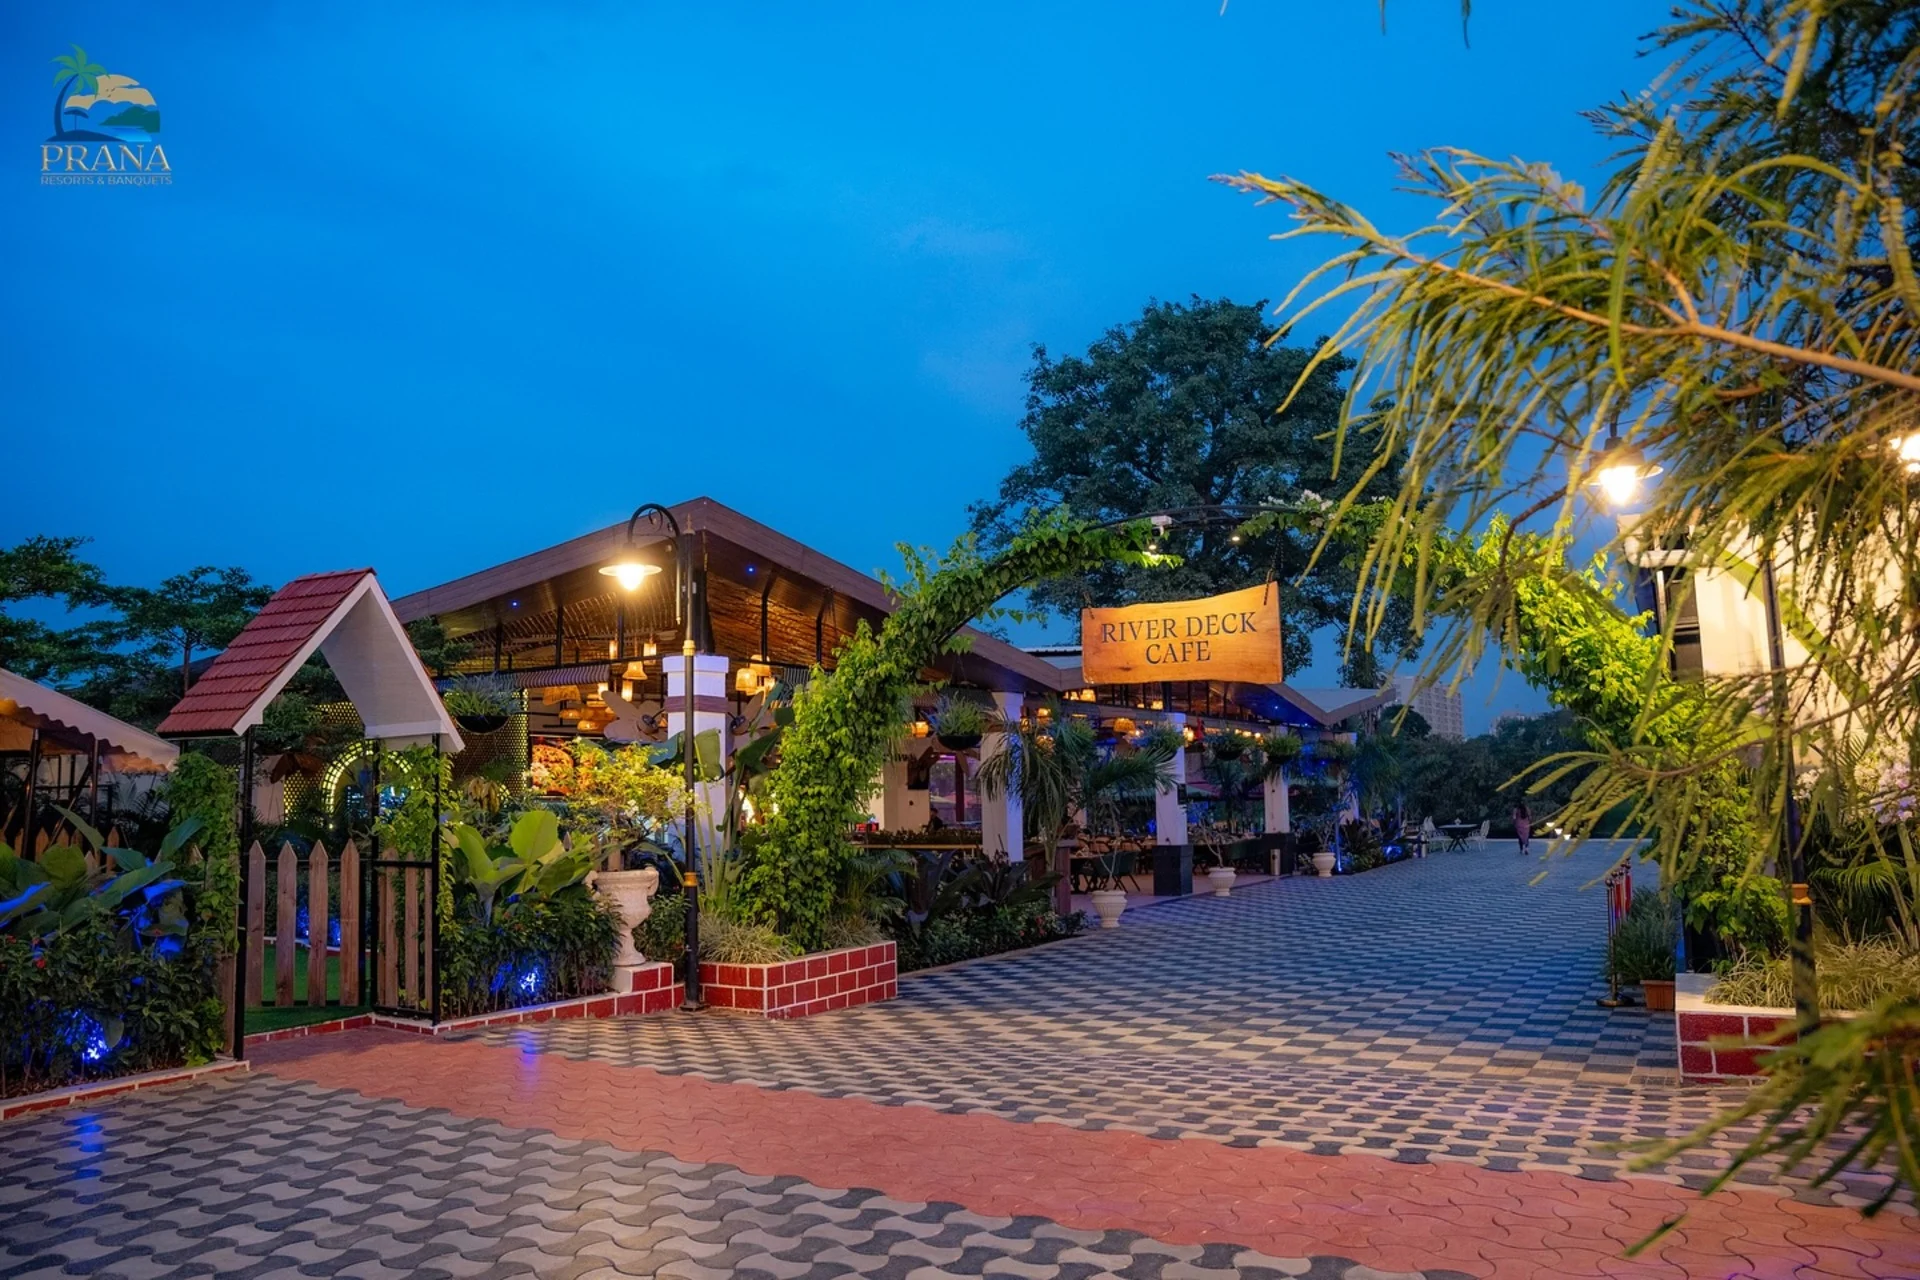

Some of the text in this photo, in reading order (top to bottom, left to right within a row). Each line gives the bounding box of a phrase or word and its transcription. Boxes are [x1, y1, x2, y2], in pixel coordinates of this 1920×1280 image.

[1101, 611, 1258, 643] RIVER DECK
[1145, 640, 1211, 664] CAFE
